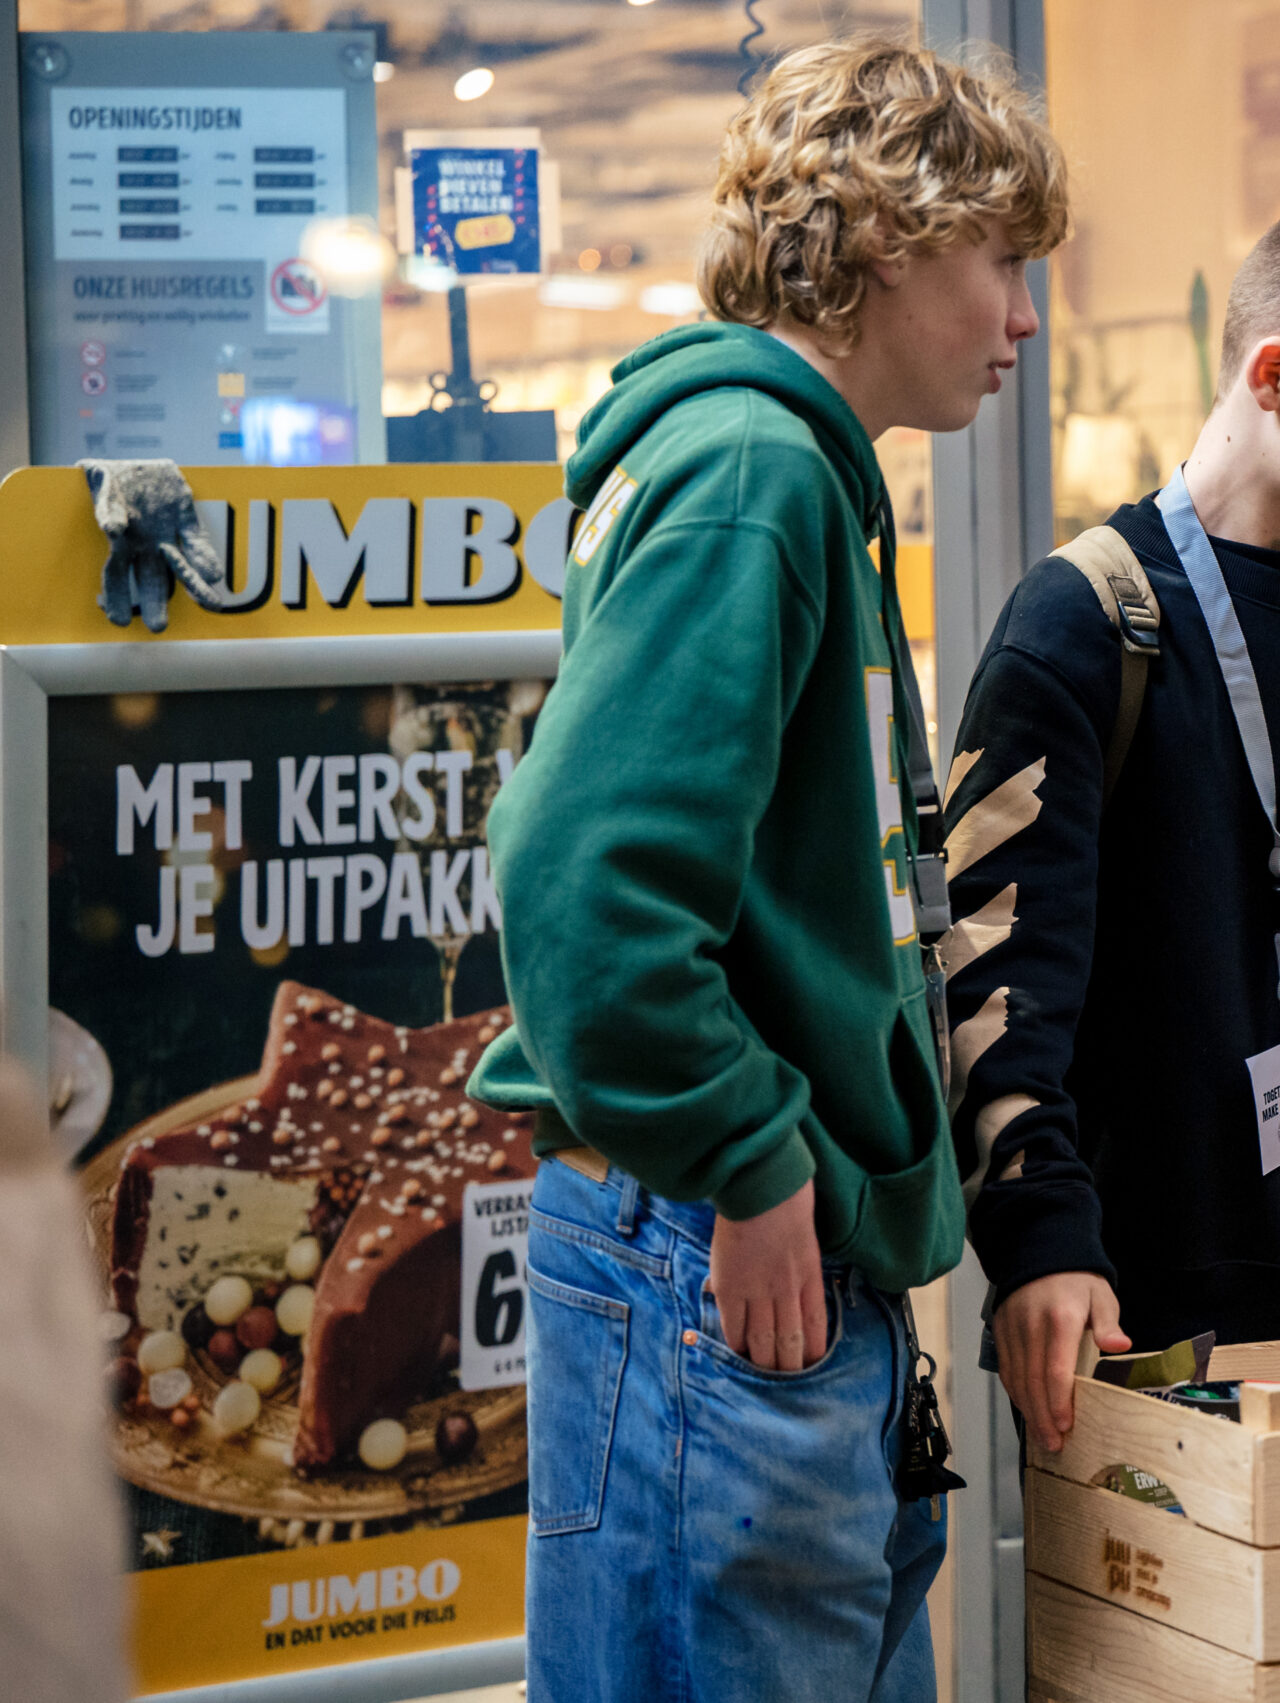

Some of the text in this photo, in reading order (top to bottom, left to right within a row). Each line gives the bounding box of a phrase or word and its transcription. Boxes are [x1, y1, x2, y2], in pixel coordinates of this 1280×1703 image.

[68, 106, 243, 133] OPENINGSTIJDEN
[438, 159, 505, 176] WINKEL
[73, 274, 254, 299] ONZE HUISREGELS
[116, 750, 473, 856] MET KERST
[136, 864, 215, 958] JE
[1262, 1105, 1279, 1123] MAKE
[474, 1193, 531, 1218] VERRA
[475, 1250, 528, 1347] 6
[262, 1557, 461, 1628] JUMBO
[266, 1604, 456, 1650] EN DAT VOOR DIE PRIJS
